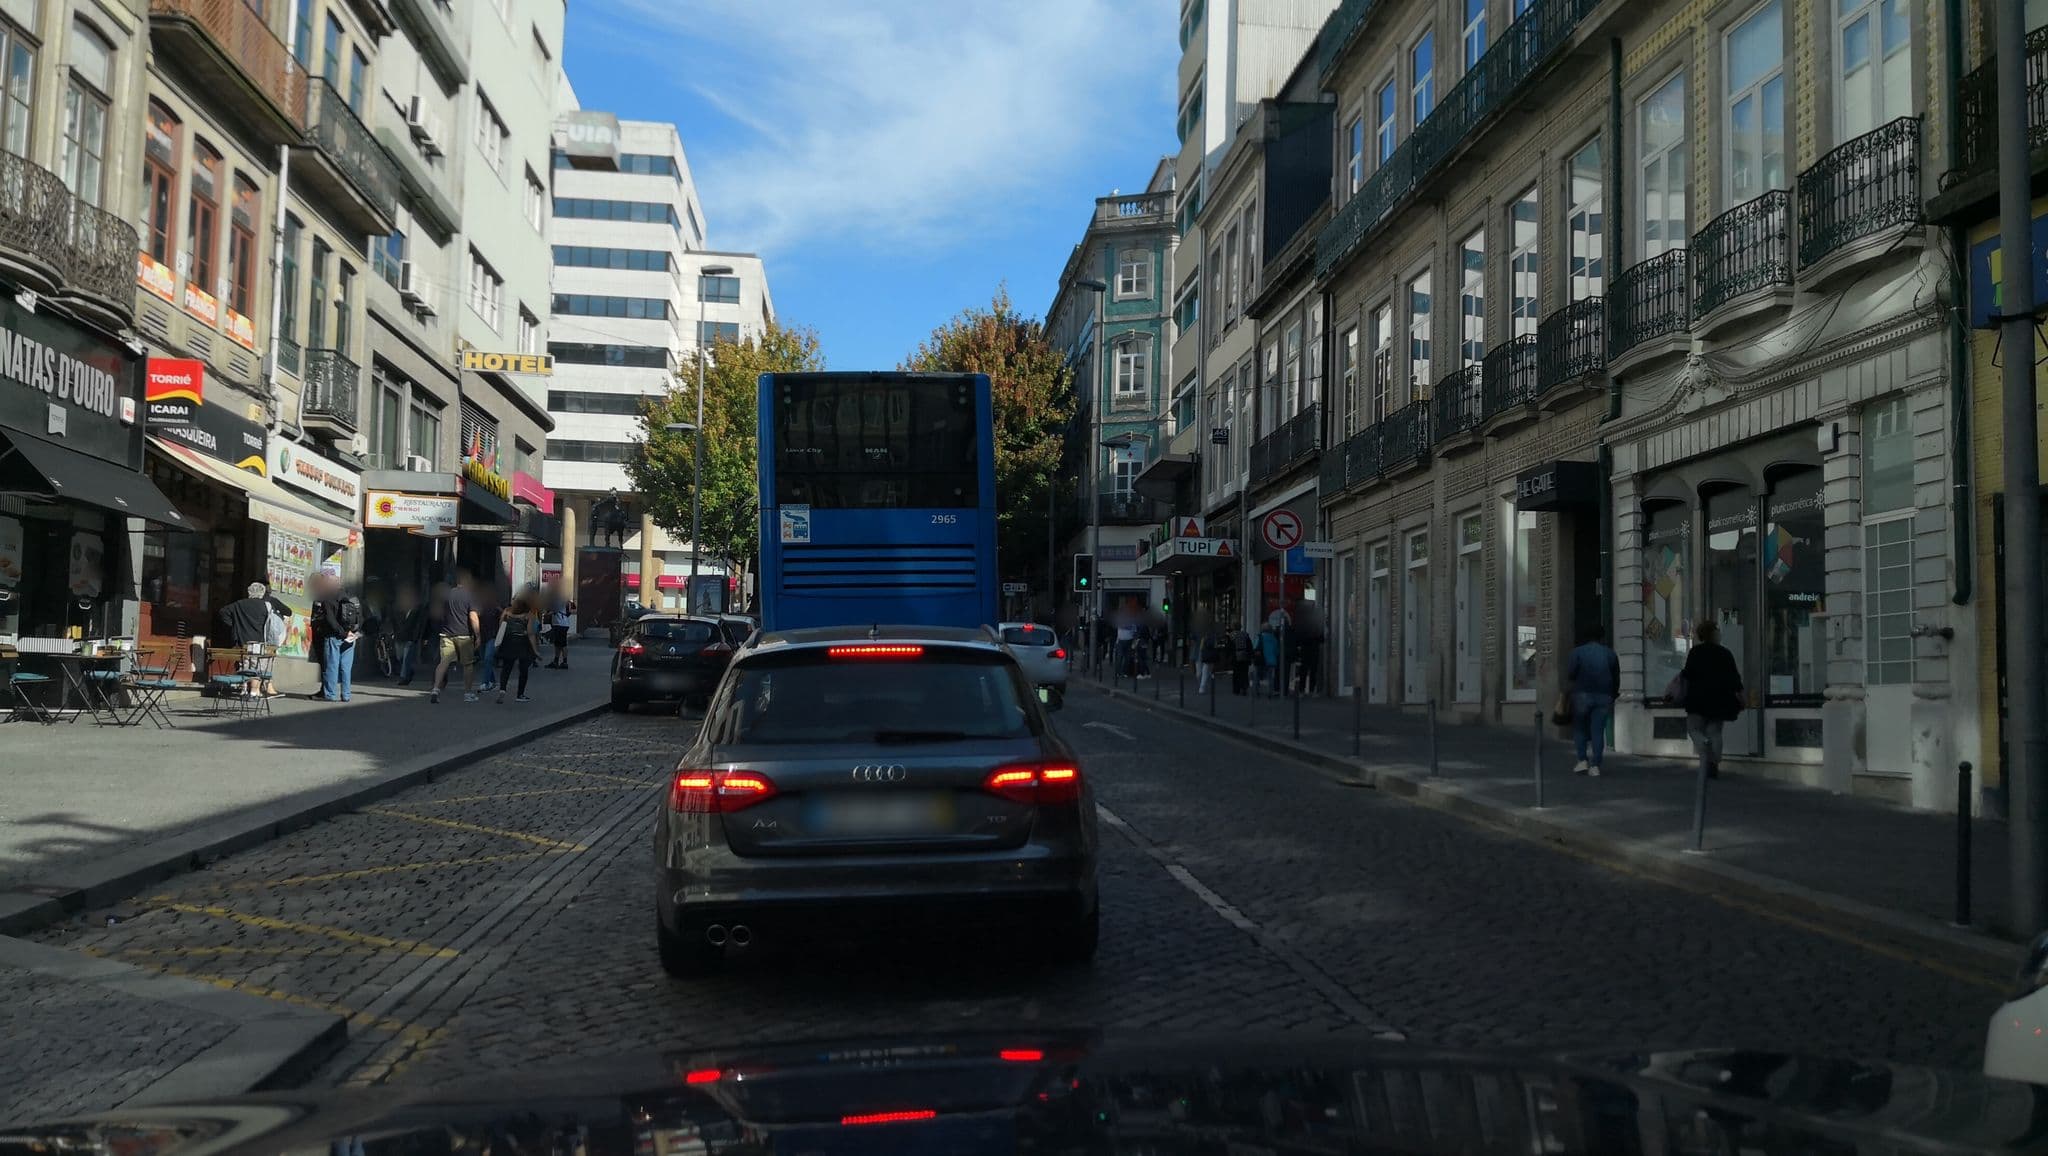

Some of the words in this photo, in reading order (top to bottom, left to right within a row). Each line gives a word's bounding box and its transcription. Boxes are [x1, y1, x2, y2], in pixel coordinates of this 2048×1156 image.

[0, 326, 55, 394] NATAS
[58, 352, 115, 417] D'OURO
[464, 351, 553, 375] HOTEL
[151, 404, 189, 415] ICARAI
[1531, 471, 1556, 494] GATE
[931, 514, 957, 525] 2965
